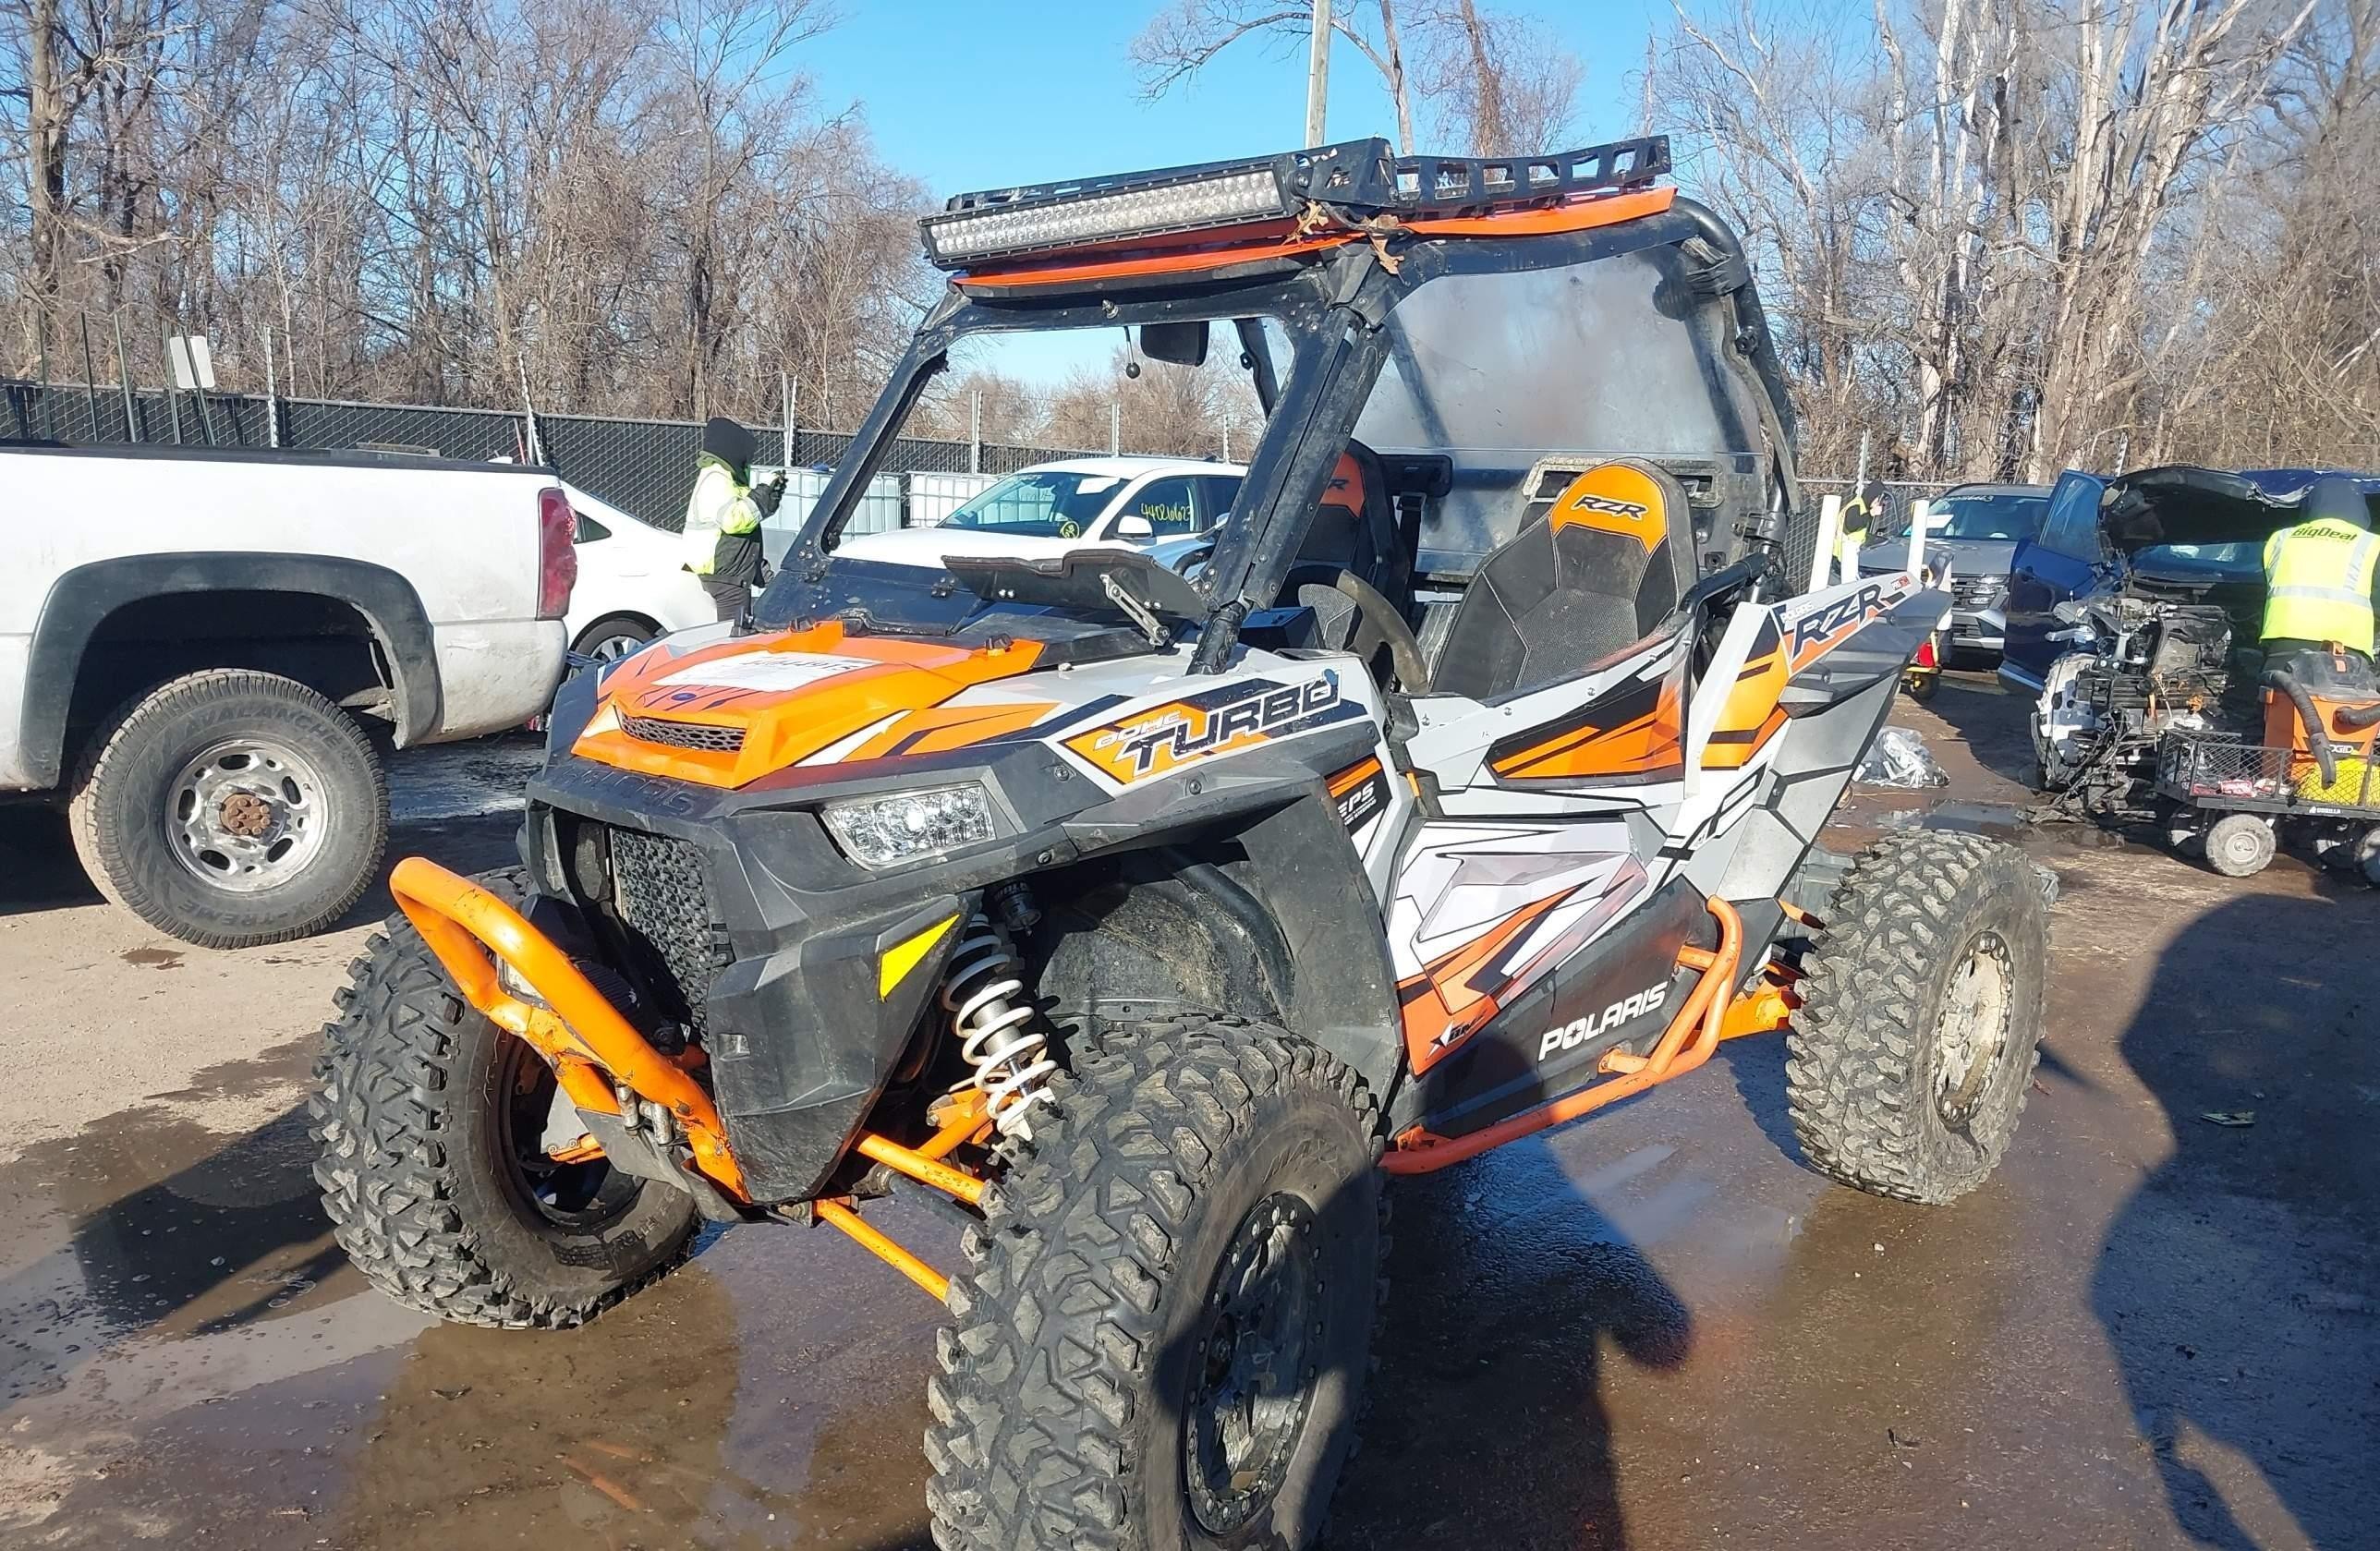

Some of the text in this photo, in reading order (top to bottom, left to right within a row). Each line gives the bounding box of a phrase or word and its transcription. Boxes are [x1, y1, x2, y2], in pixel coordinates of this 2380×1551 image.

[1571, 493, 1648, 520] RZR
[1791, 582, 1888, 662] RZR
[186, 706, 343, 750] AVALANCHE
[1112, 669, 1342, 778] TURBO
[1337, 781, 1375, 818] EPS
[1537, 981, 1668, 1061] POLARIS
